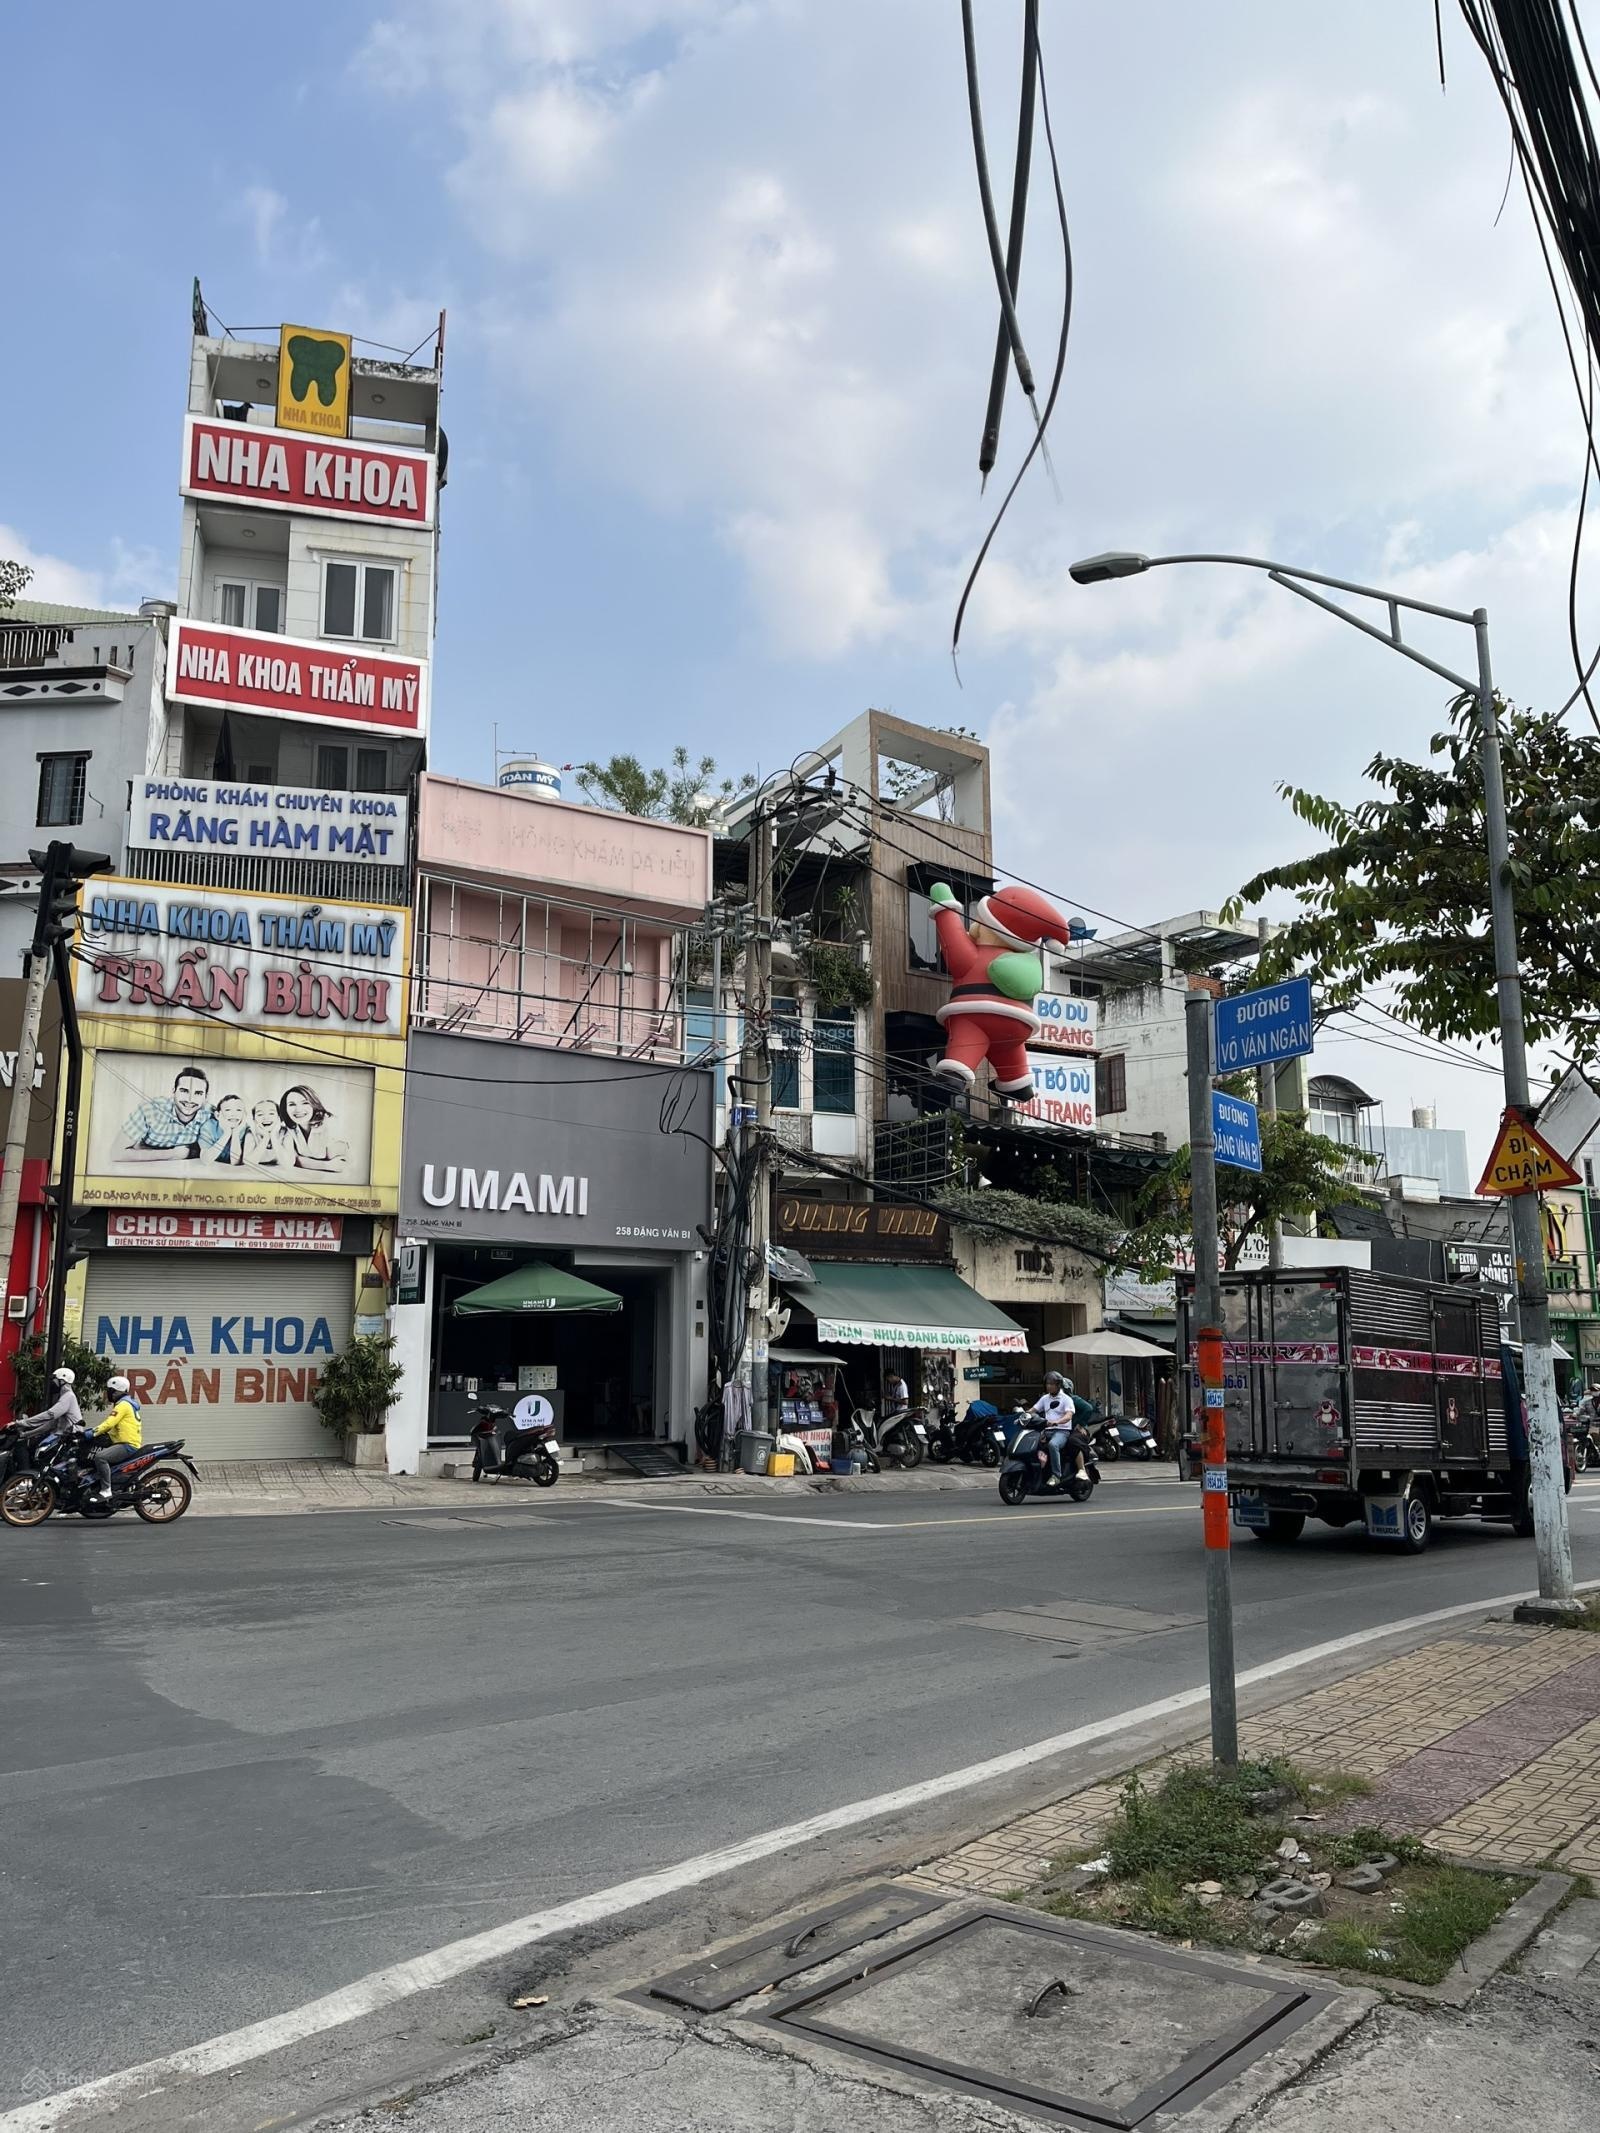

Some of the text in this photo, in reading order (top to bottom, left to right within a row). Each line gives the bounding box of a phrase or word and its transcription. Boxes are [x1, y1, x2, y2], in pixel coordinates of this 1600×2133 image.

[284, 407, 341, 430] NHA KHOA
[197, 432, 418, 510] NHA KHOA
[180, 644, 418, 712] NHA KHOA THẨM MỸ
[145, 782, 398, 817] PHÒNG KHÁM CHUYÊN KHOA
[150, 809, 394, 858] RĂNG HÀM MẶT
[91, 897, 397, 957] NHA KHOA THẨM MỸ
[93, 947, 390, 1023] TRẦN BÌNH
[1236, 994, 1290, 1024] ĐƯỜNG
[1040, 1024, 1094, 1046] TRANG
[1220, 1020, 1309, 1063] VÕ VĂN NGÂN
[1045, 1101, 1092, 1126] TRANG
[1219, 1103, 1249, 1127] ĐƯỜNG
[1213, 1128, 1235, 1158] ĐẶNG
[1235, 1133, 1252, 1162] VĂN
[1509, 1137, 1528, 1154] ĐI
[422, 1163, 589, 1216] UMAMI
[115, 1214, 335, 1239] CHO THUÊ NHÀ
[616, 1226, 691, 1239] 258 ĐẶNG VĂN BI
[779, 1199, 939, 1237] QUANG VINH
[96, 1315, 194, 1355] NHA
[210, 1315, 334, 1355] KHOA
[1236, 1345, 1298, 1360] LUXURY
[118, 1357, 220, 1405] RẦN
